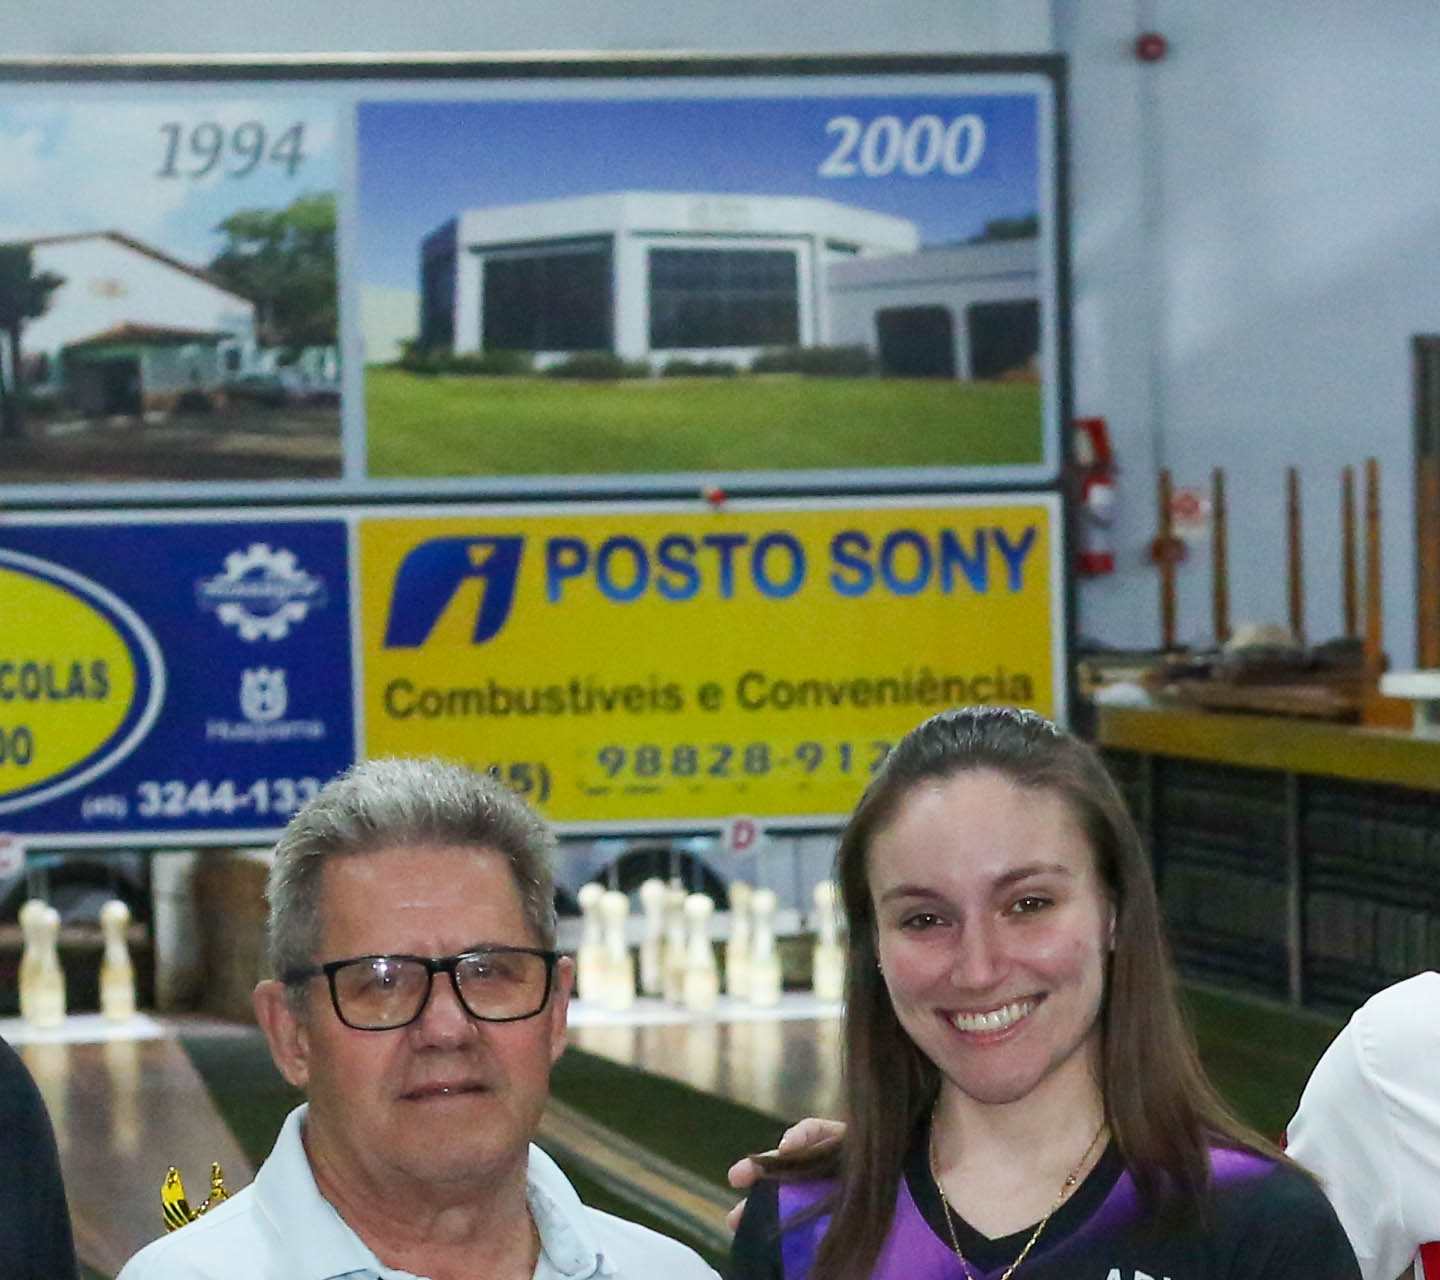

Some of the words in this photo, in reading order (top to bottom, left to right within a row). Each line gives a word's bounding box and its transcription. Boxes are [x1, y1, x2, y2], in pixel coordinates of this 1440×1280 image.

[156, 120, 307, 181] 1994
[818, 114, 986, 178] 2000
[545, 530, 807, 604] POSTO
[829, 526, 1038, 597] SONY
[383, 672, 684, 721] Combustíveis
[698, 682, 723, 712] e
[735, 667, 1035, 711] Conveniência
